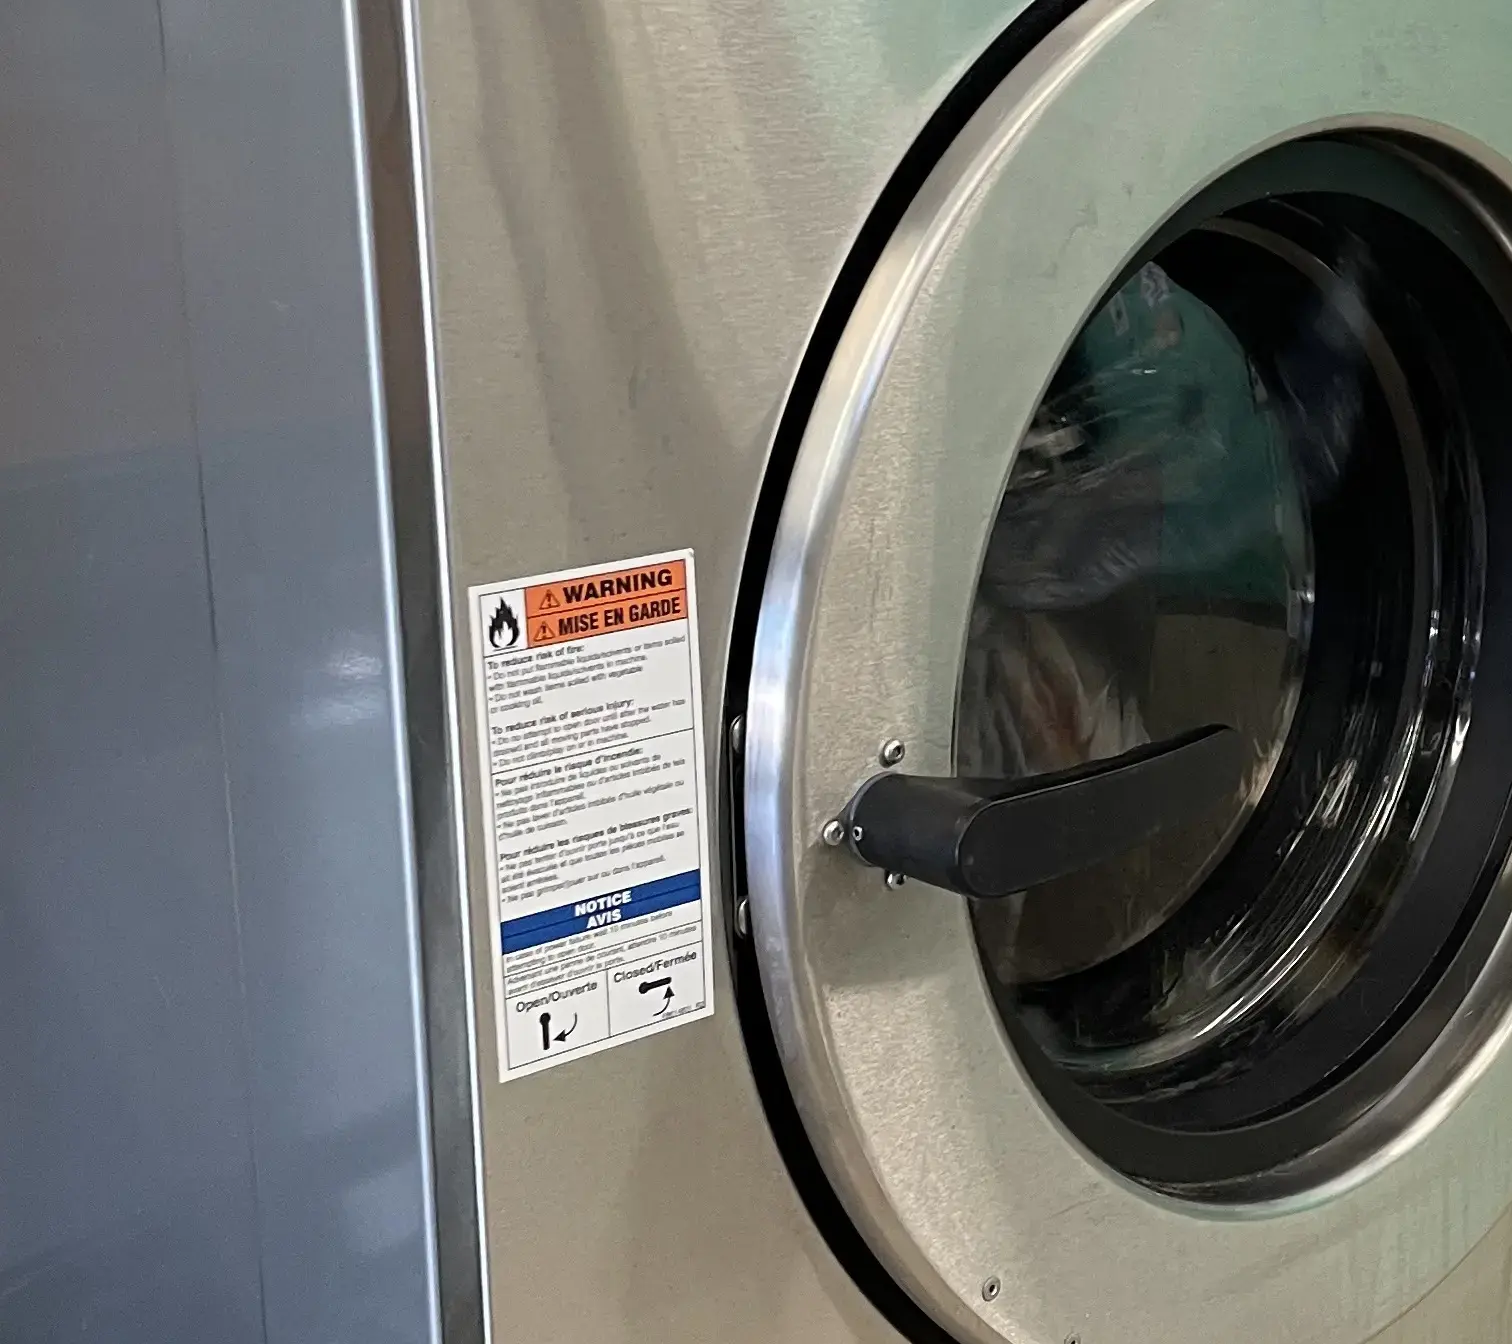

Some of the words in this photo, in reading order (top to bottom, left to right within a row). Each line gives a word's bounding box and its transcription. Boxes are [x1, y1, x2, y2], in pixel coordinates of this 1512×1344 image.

[562, 569, 672, 604] WARNING
[558, 612, 599, 636] MISE
[604, 607, 624, 627] EN
[629, 597, 681, 622] GARDE
[574, 890, 632, 917] NOTICE
[586, 909, 622, 930] AVIS
[516, 981, 598, 1013] Open/Ouverte
